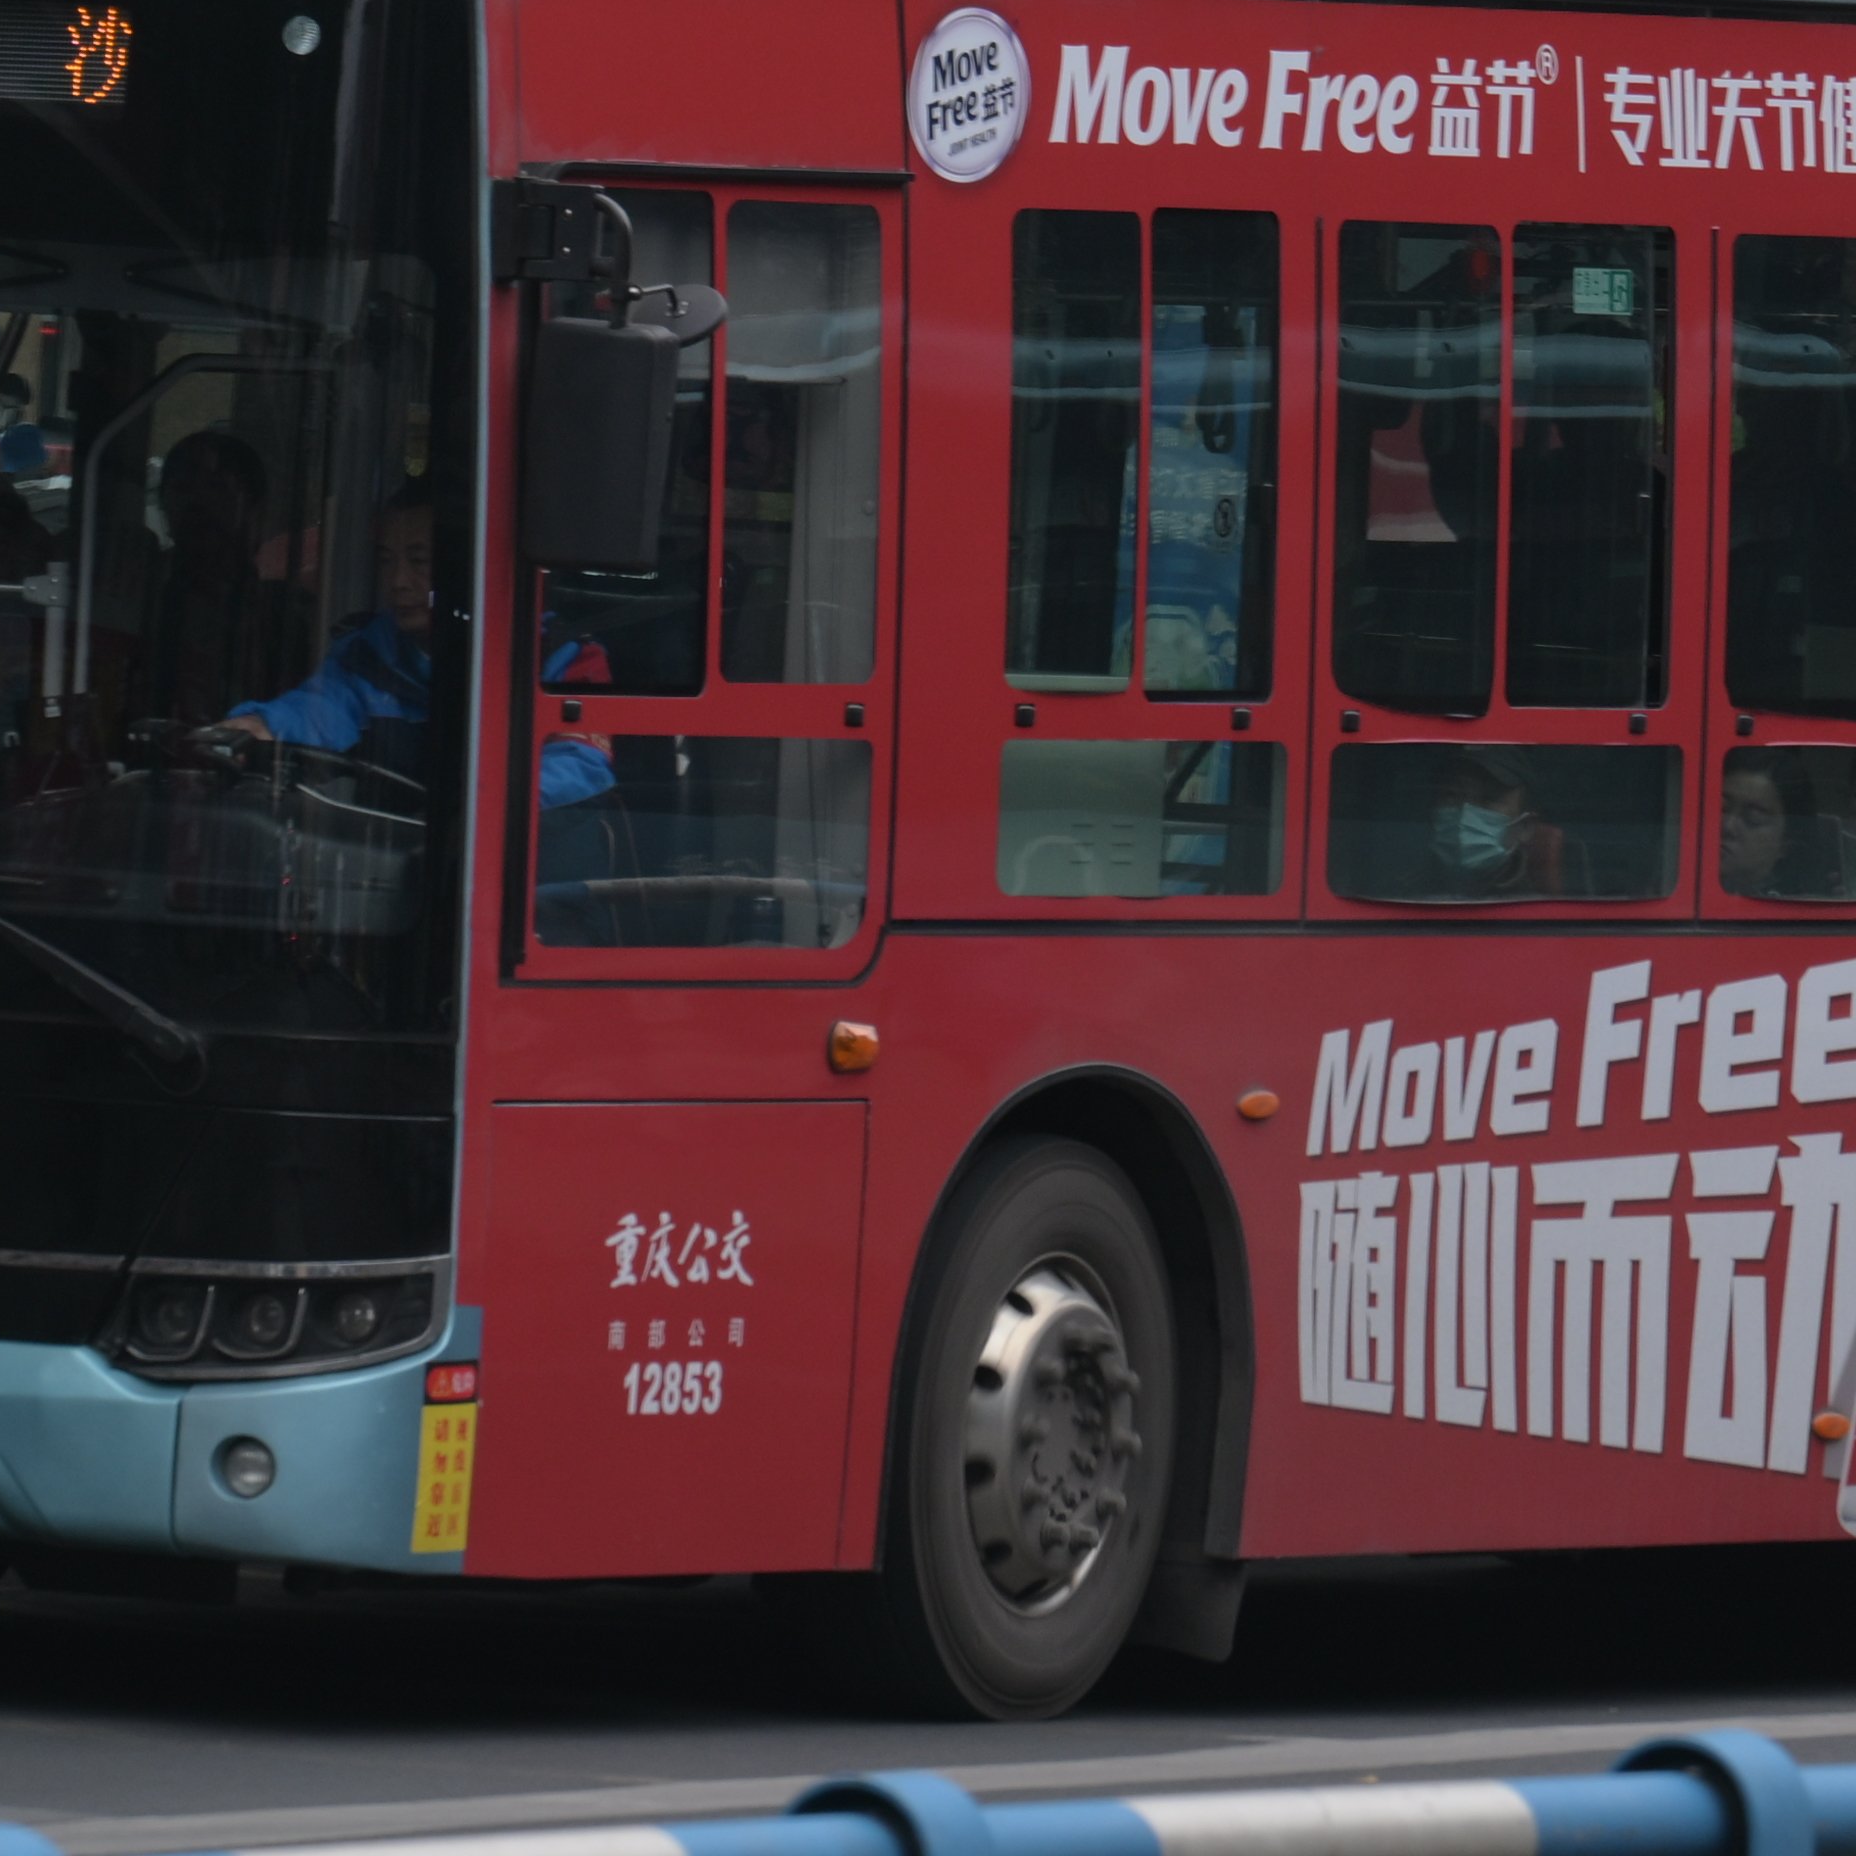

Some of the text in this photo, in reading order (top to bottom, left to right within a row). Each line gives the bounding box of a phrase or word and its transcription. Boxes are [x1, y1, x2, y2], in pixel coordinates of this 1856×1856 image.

[64, 7, 133, 105] 沙
[932, 41, 998, 92] Move
[926, 91, 978, 140] Free
[1048, 44, 1249, 148] Move
[1258, 49, 1420, 155] Free
[1305, 1018, 1559, 1156] Move
[605, 1210, 754, 1288] 重庆公交
[607, 1316, 747, 1351] 南部公司
[623, 1360, 723, 1415] 12853
